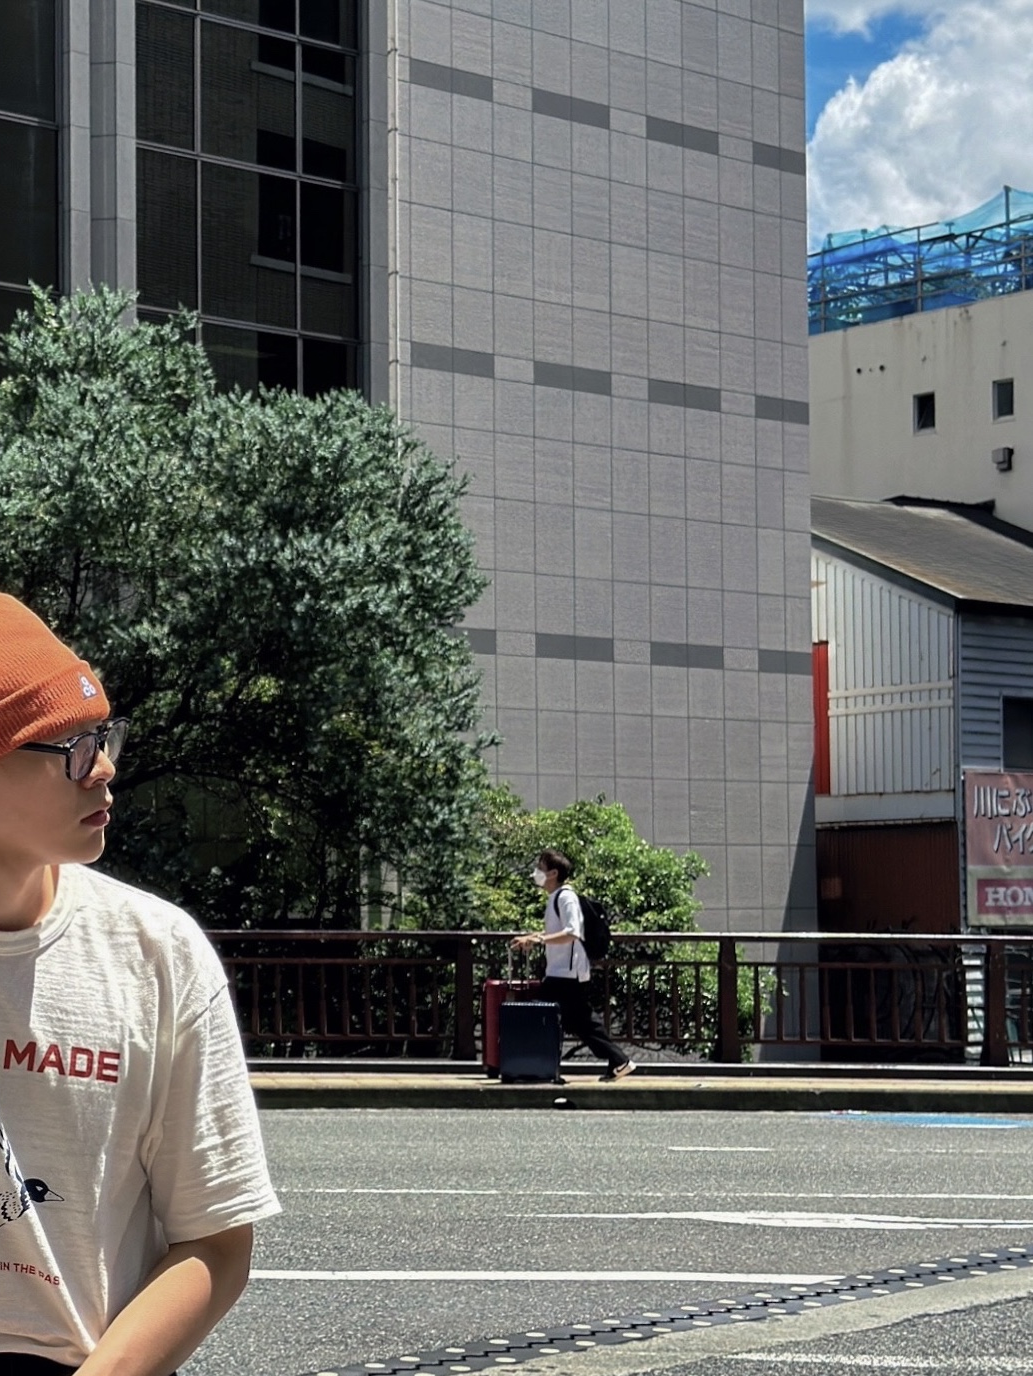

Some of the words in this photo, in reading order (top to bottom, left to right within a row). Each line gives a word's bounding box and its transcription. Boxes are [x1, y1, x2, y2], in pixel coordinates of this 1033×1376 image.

[3, 1039, 121, 1083] MADE
[0, 1261, 10, 1272] IN
[13, 1263, 36, 1275] THE
